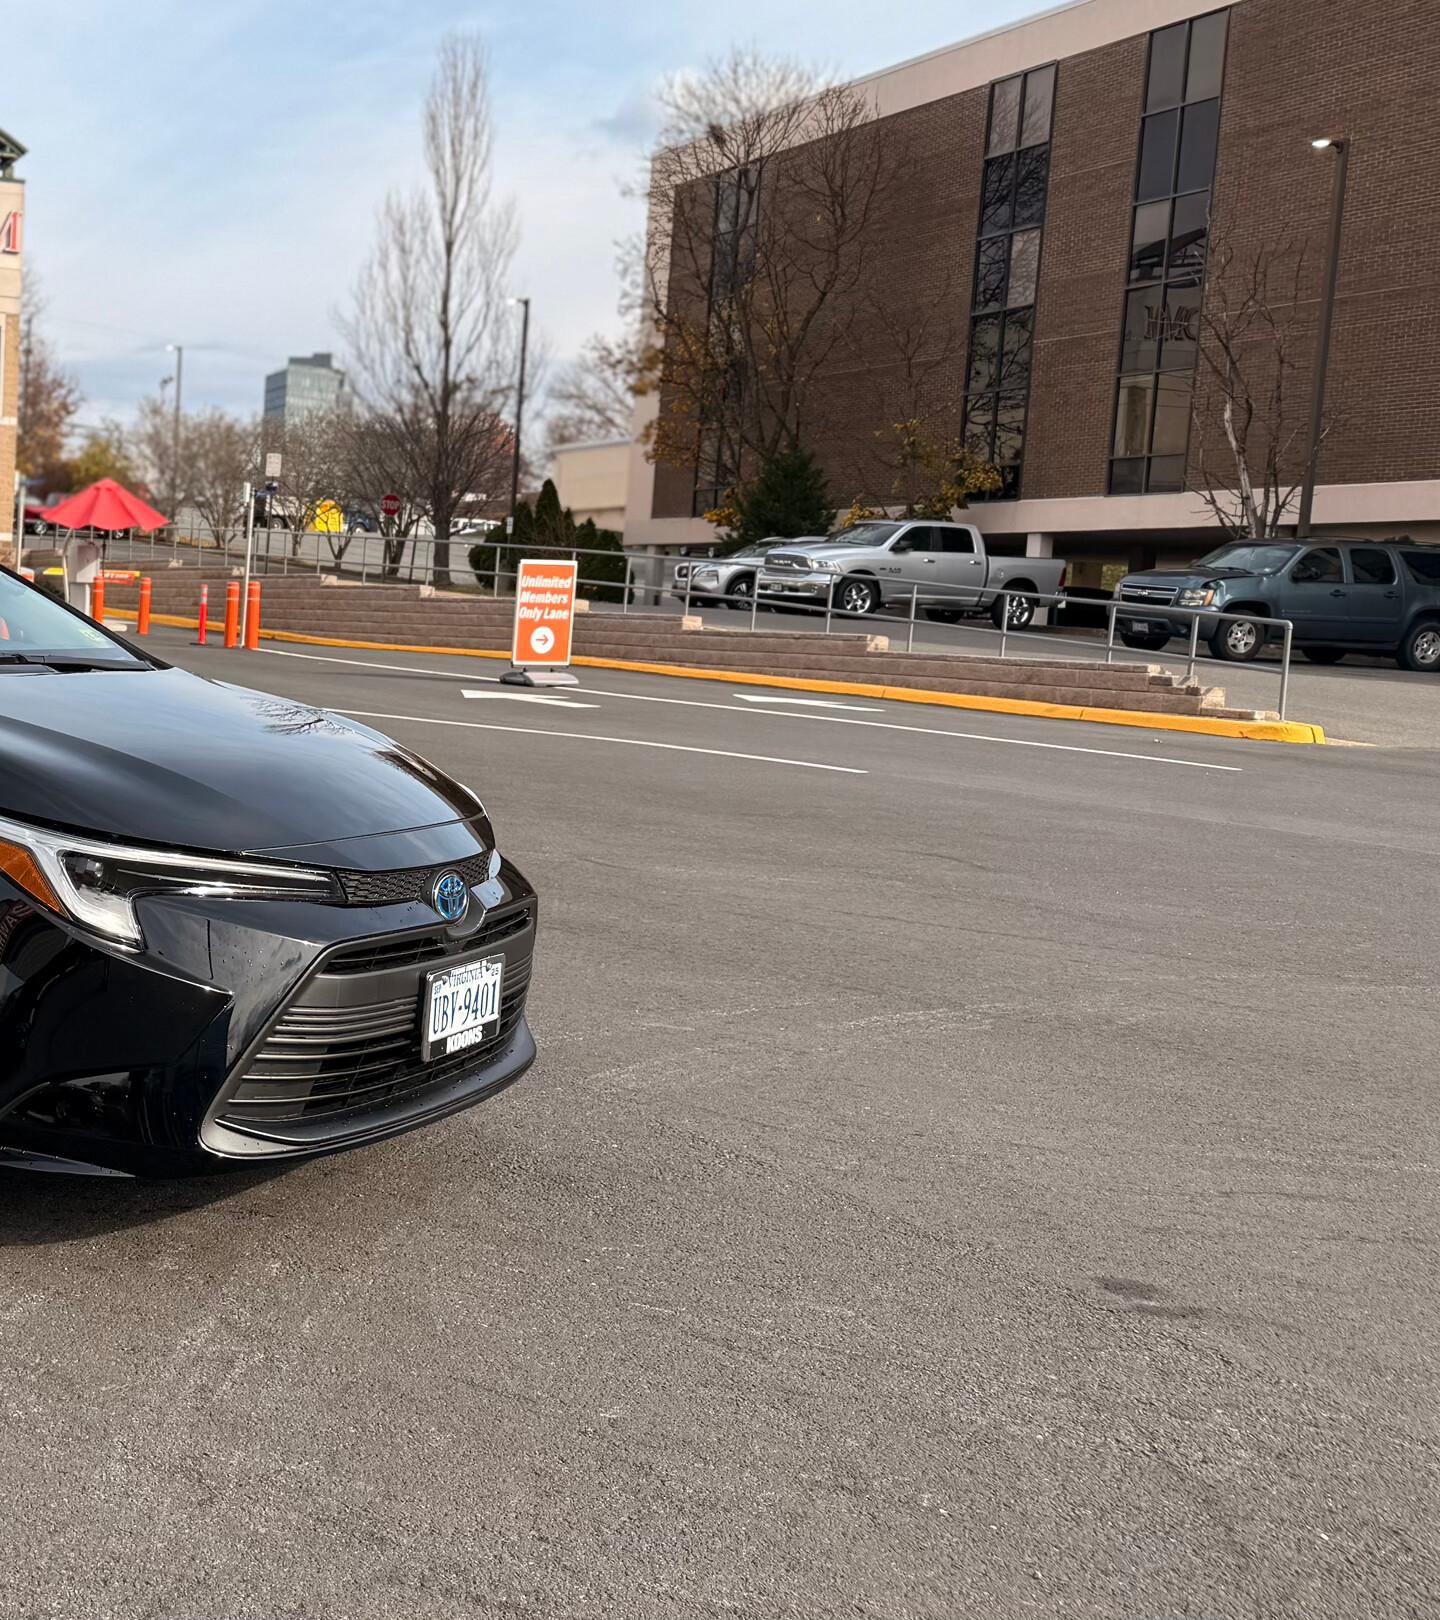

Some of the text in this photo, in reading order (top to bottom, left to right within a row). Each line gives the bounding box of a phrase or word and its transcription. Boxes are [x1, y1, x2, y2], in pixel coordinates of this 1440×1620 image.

[382, 500, 400, 510] STOP
[521, 575, 573, 589] Unlimited
[520, 591, 569, 604] Members
[519, 606, 569, 621] Only Lane
[446, 1025, 483, 1054] KOONS
